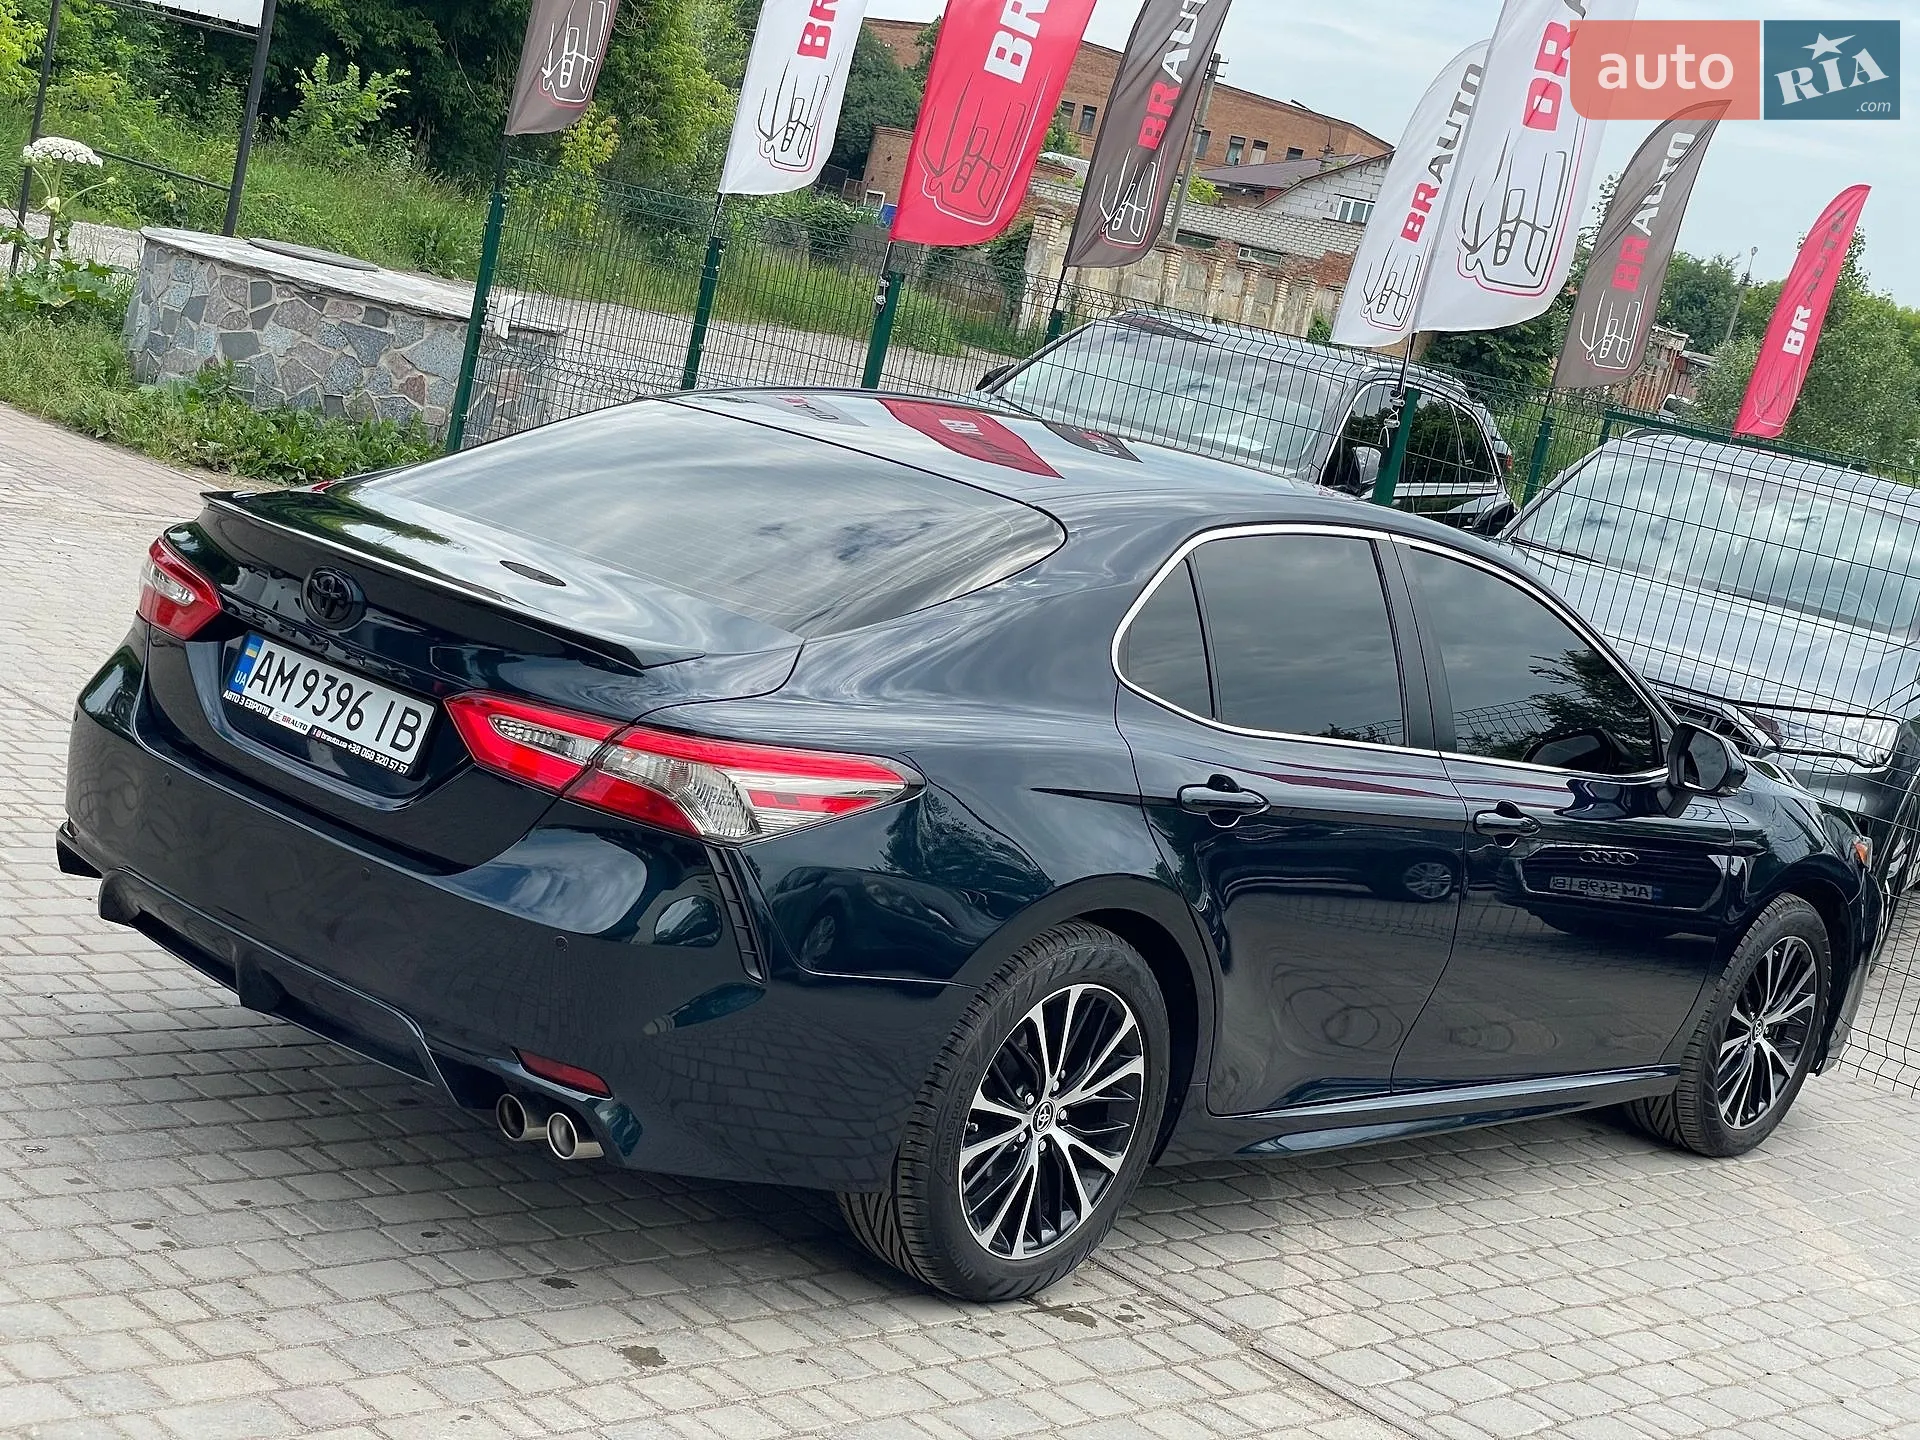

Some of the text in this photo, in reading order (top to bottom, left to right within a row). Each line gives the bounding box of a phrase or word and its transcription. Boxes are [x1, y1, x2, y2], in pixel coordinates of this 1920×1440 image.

[1400, 63, 1483, 243] BRAUTO
[234, 670, 247, 685] UA
[248, 650, 302, 702] AM
[294, 669, 374, 731] 9396
[281, 715, 308, 732] BRAUTO
[375, 752, 389, 767] 320
[388, 760, 399, 771] 57
[398, 764, 409, 775] 57
